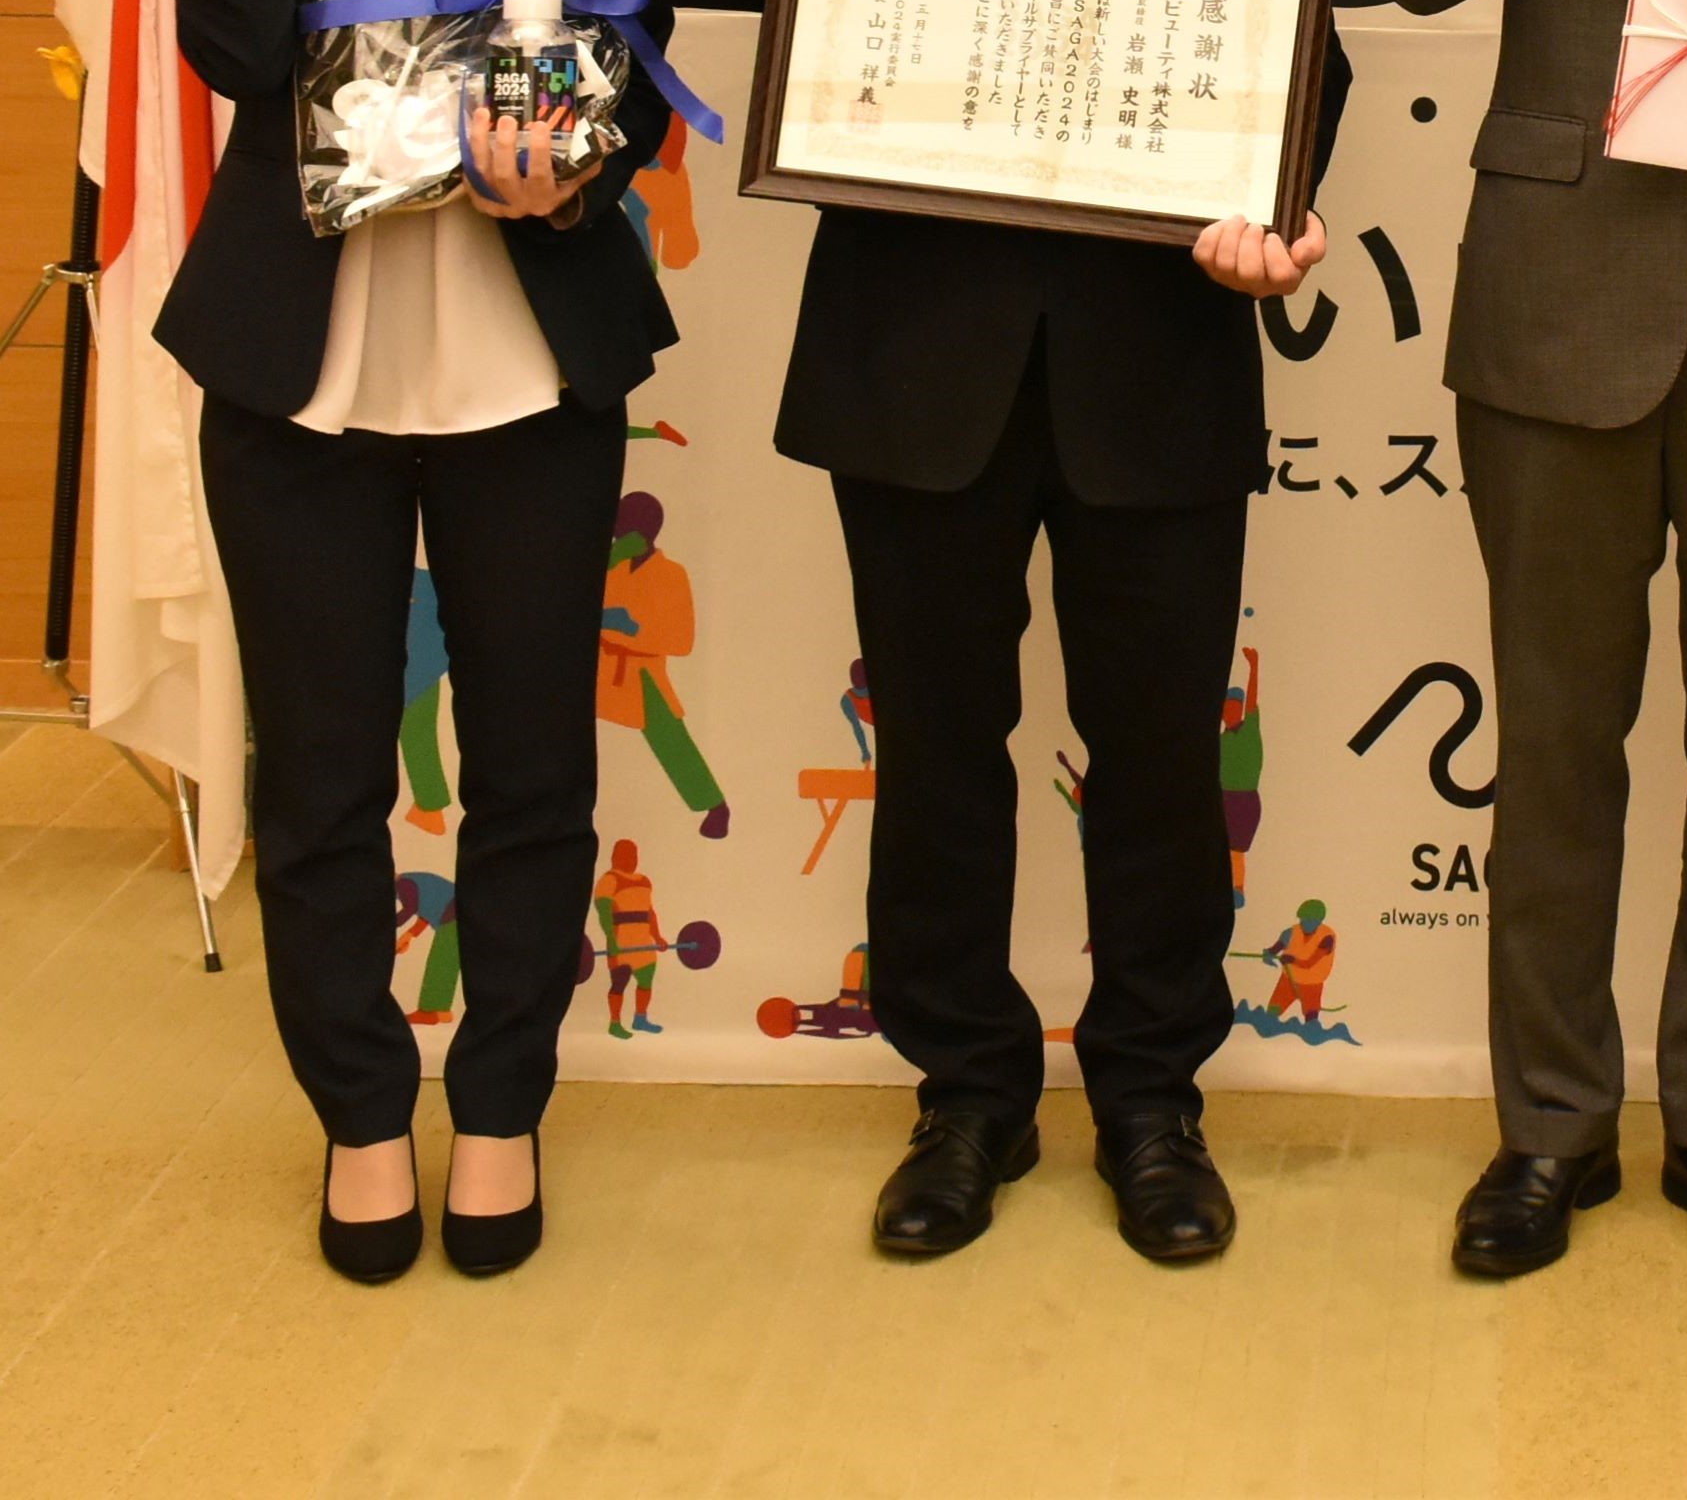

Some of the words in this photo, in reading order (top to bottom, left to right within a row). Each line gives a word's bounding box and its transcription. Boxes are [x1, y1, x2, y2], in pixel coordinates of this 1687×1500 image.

[494, 72, 531, 84] SAGA
[494, 83, 531, 96] 2024
[1410, 843, 1491, 892] SA
[1380, 908, 1449, 929] always
[1456, 912, 1479, 926] on
